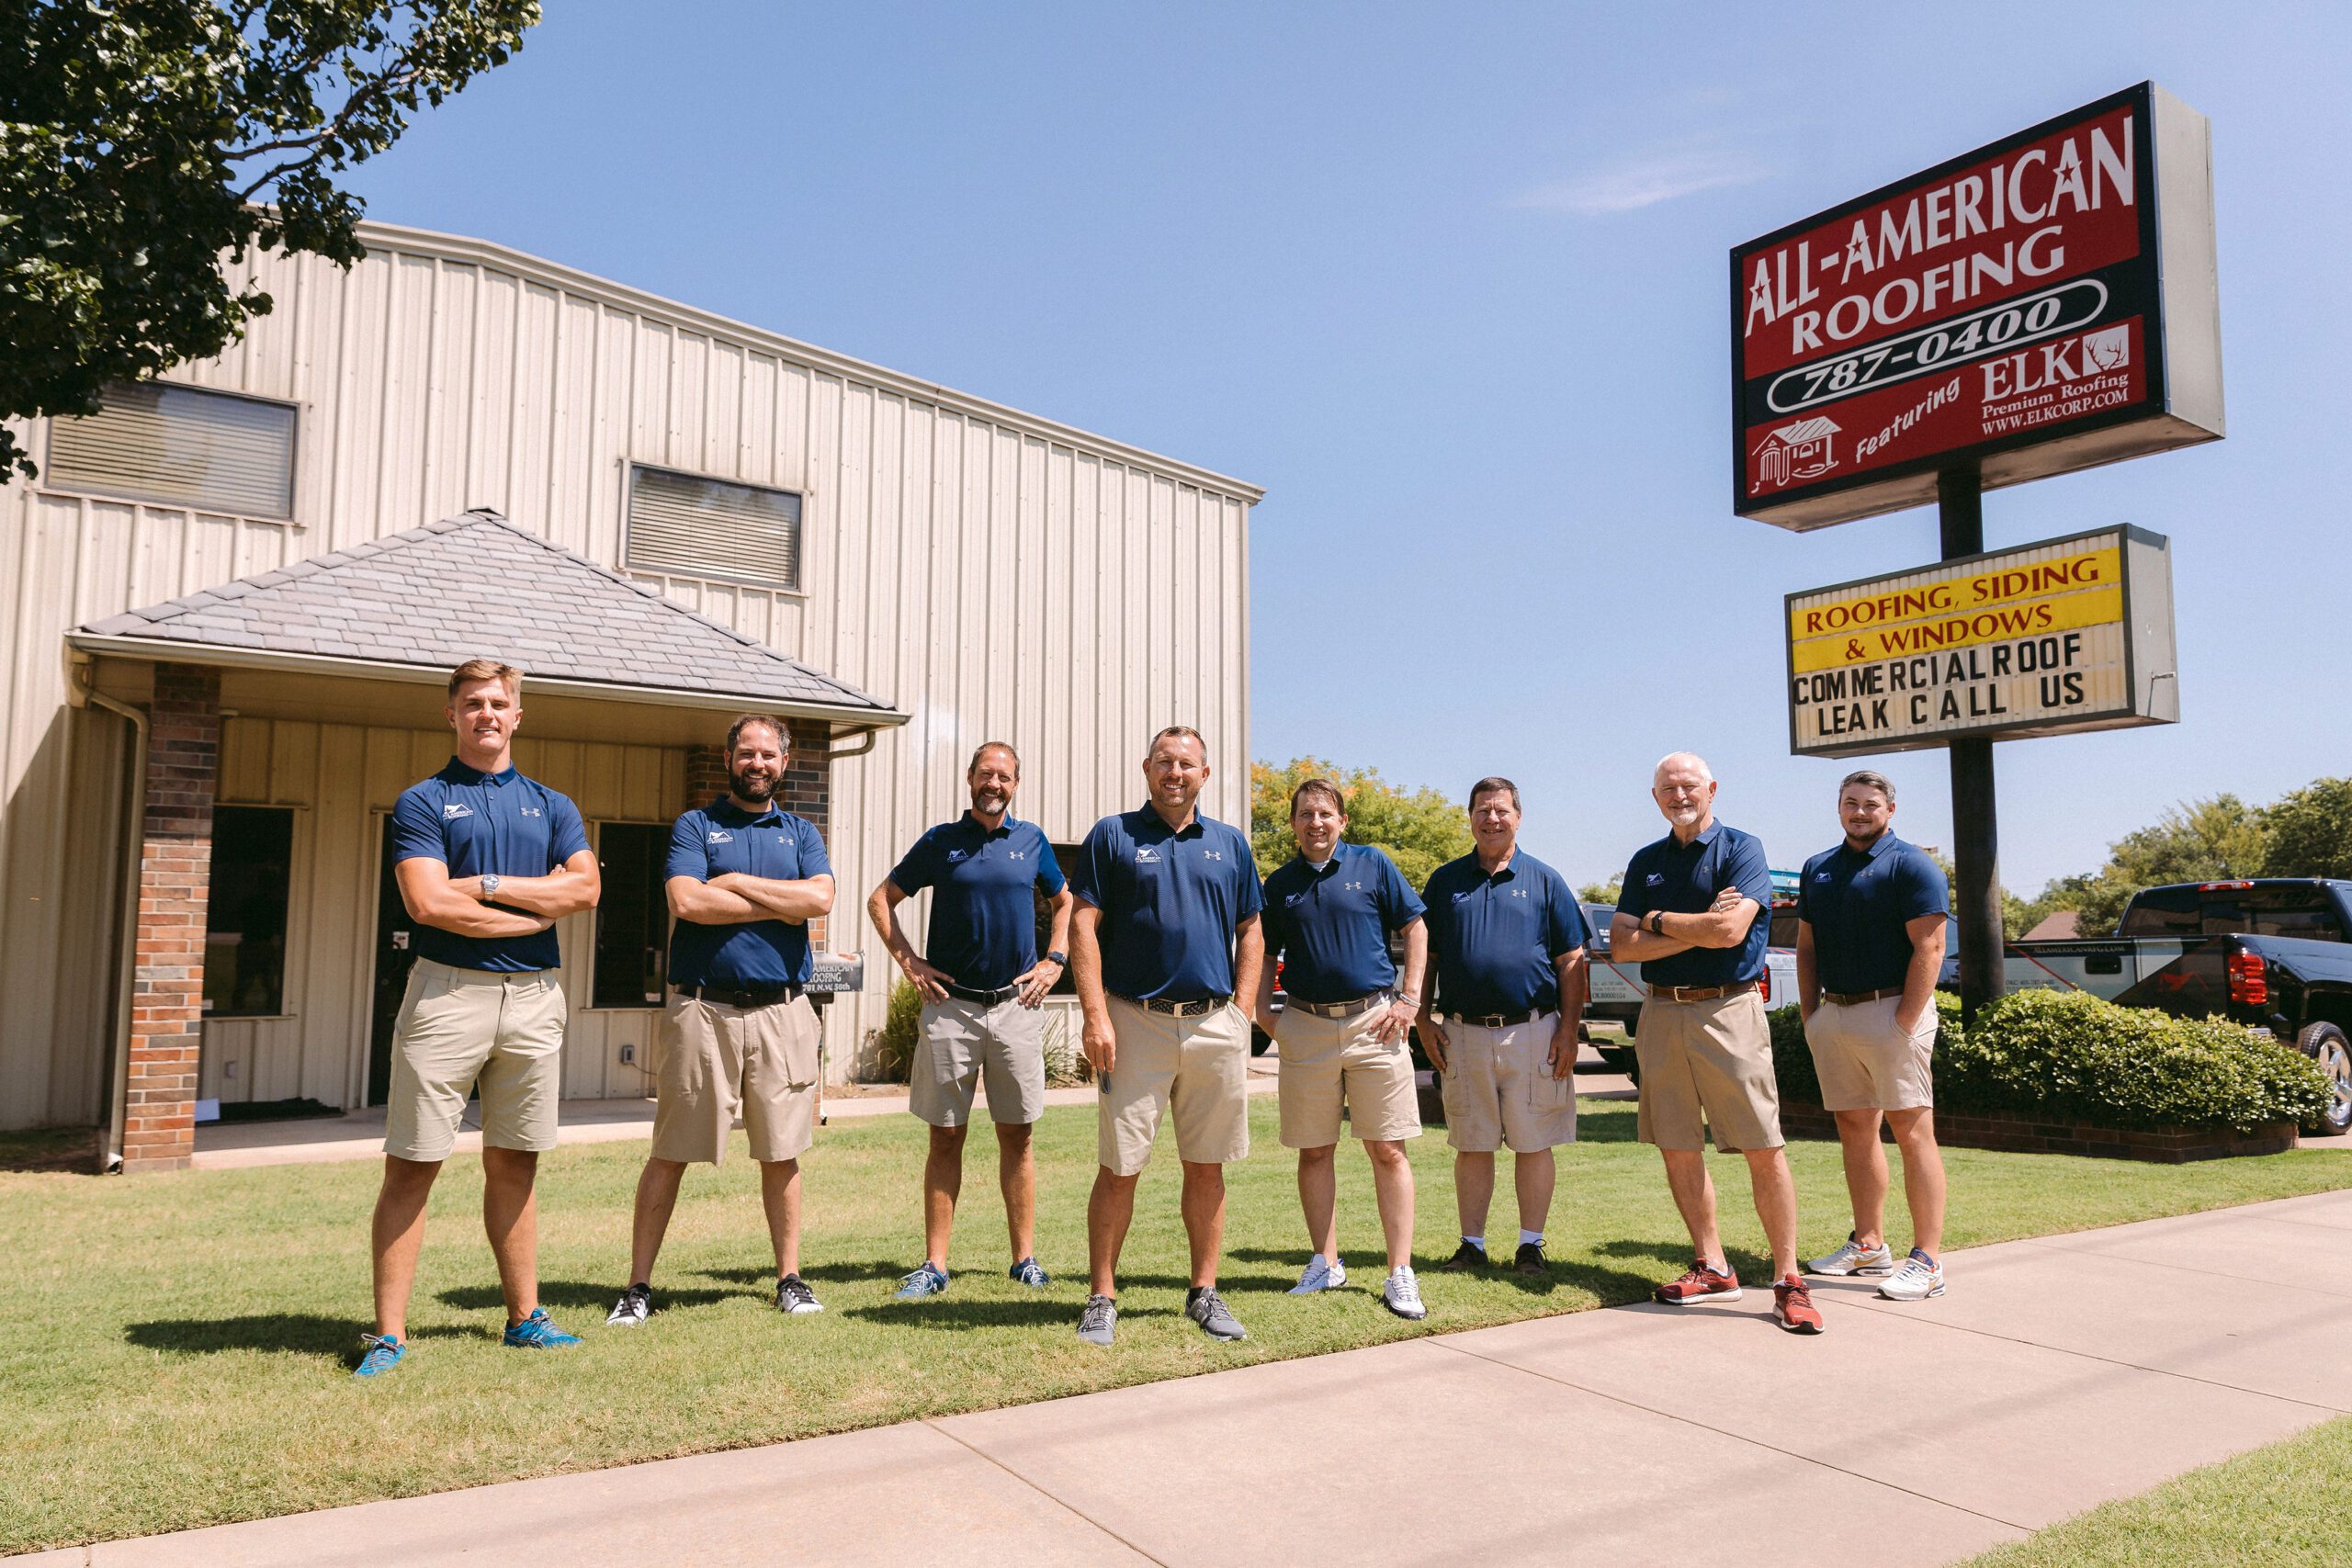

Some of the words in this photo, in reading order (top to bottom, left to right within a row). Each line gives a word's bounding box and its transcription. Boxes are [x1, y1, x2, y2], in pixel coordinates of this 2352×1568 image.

[1746, 115, 2134, 338] ALL-AMERICAN
[1792, 225, 2064, 355] ROOFING
[1801, 297, 2062, 401] 787-0400
[1979, 337, 2083, 403] ELK
[1855, 376, 1961, 464] Featuring
[1982, 392, 2054, 419] Premium
[2061, 373, 2129, 400] Roofing
[1982, 388, 2129, 436] WWW.ELKCORP.COM
[1806, 585, 1961, 633] ROOFING,
[1973, 557, 2099, 602] SIDING
[1845, 638, 1866, 660] &
[1879, 604, 2052, 654] WINDOWS
[1818, 699, 1889, 736] LEAK
[1911, 683, 2007, 725] CALL
[2041, 671, 2084, 708] US
